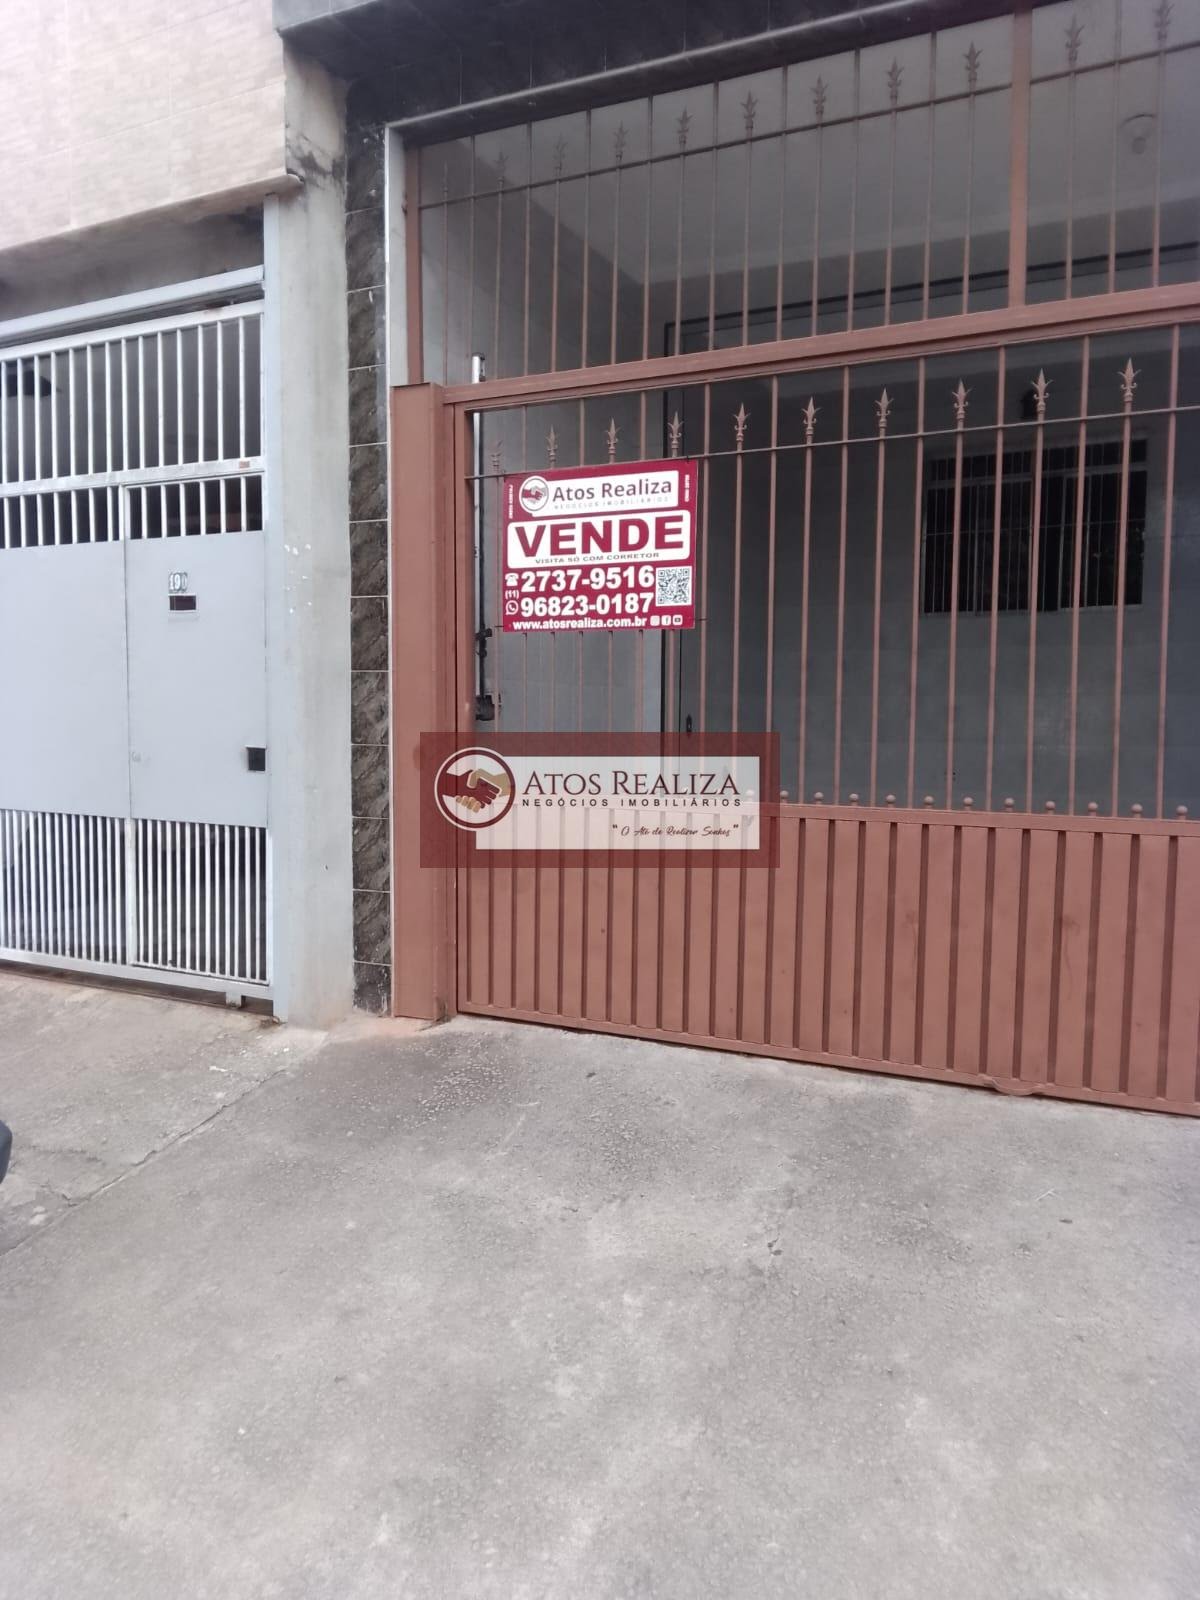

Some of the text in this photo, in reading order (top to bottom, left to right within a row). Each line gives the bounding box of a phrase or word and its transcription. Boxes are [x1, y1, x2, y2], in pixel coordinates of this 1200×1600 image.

[552, 486, 595, 502] Atos
[601, 478, 672, 498] Realiza
[515, 515, 684, 557] VENDE
[582, 554, 604, 562] COM
[606, 552, 660, 561] CORRETOR
[521, 565, 655, 592] 2737-9516
[505, 589, 520, 600] (11)
[520, 592, 654, 617] 96823-0187
[513, 616, 647, 630] www.atosrealiza.com.br
